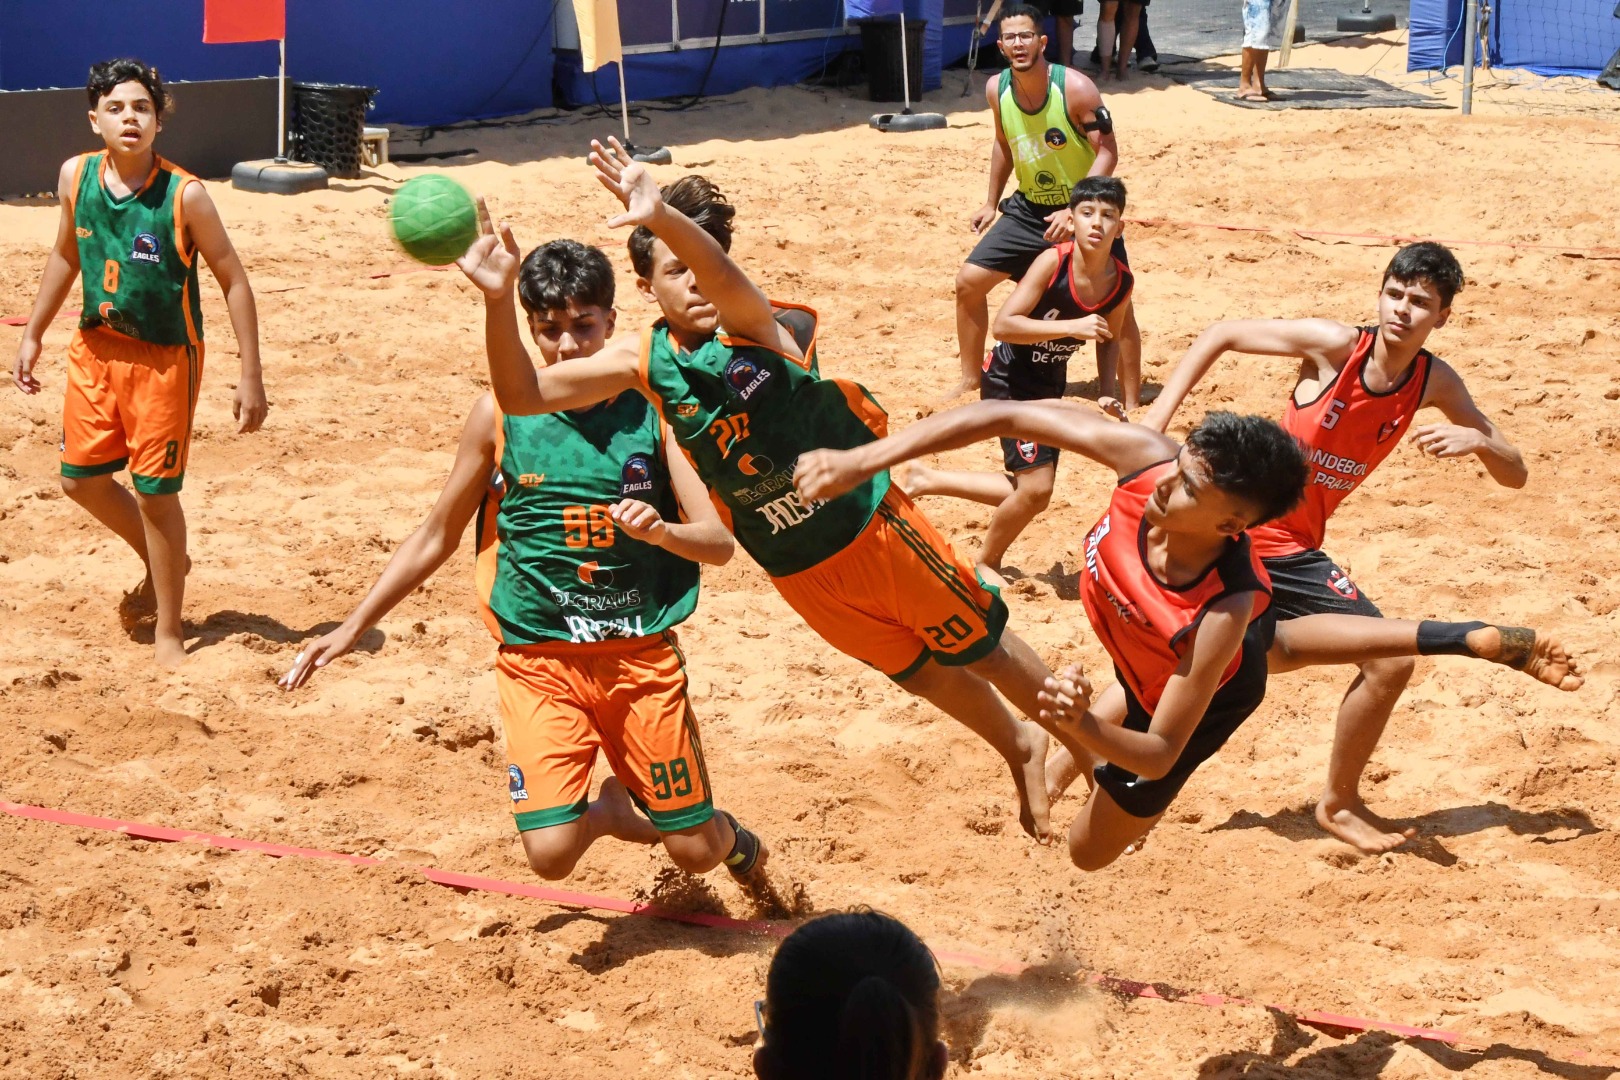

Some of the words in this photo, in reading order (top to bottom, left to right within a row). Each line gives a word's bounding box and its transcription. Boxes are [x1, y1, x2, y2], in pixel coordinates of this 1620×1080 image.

[132, 250, 160, 263] EAGLES
[103, 258, 120, 294] 8
[1031, 350, 1051, 363] DE
[740, 369, 771, 401] EAGLES
[1321, 399, 1345, 430] 5
[709, 412, 750, 460] 20
[163, 440, 179, 470] 8
[518, 473, 545, 485] STY
[623, 480, 653, 494] EAGLES
[1313, 471, 1356, 491] PRAIA
[562, 503, 615, 549] 99
[922, 613, 974, 649] 20
[650, 756, 693, 801] 99
